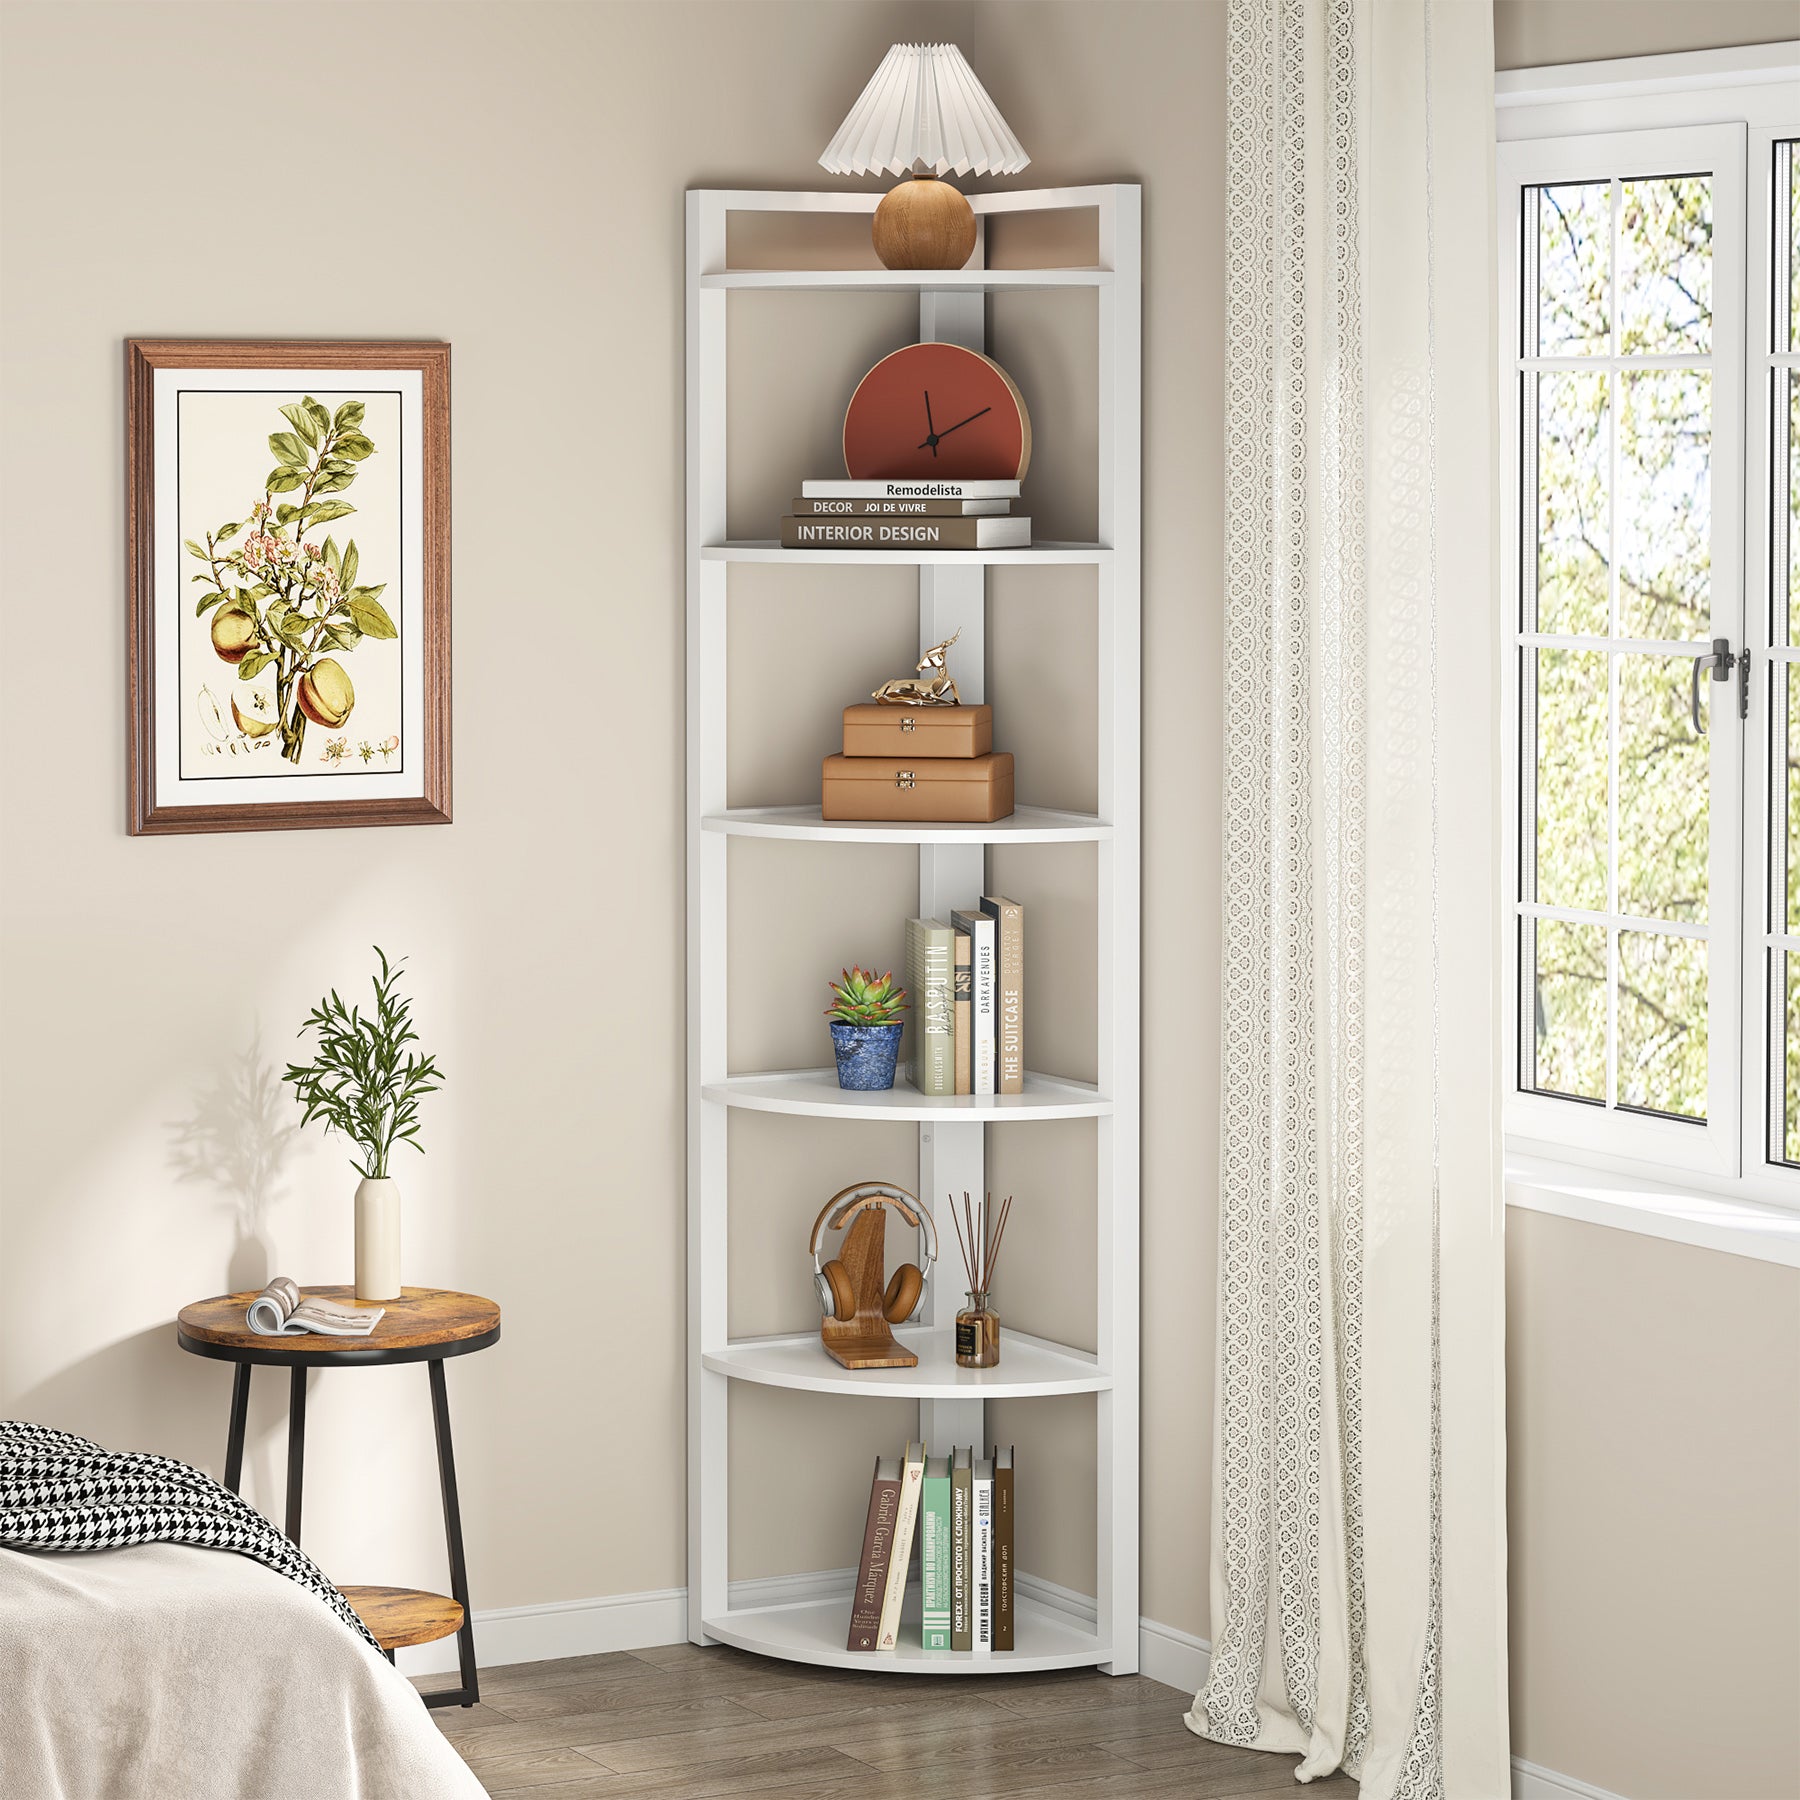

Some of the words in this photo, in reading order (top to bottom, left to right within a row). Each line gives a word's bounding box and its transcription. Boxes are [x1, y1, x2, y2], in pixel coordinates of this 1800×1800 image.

[886, 484, 962, 496] Remodelista
[813, 502, 853, 513] DECOR
[864, 503, 880, 513] JOI
[883, 503, 896, 513] DE
[898, 503, 927, 513] VIVRE
[798, 525, 873, 541] INTERIOR
[879, 526, 940, 542] DESIGN
[925, 946, 948, 1034] RASPUTIN
[1005, 990, 1018, 1052] SUITCASE
[1005, 1057, 1018, 1080] THE
[877, 1489, 896, 1525] Gabriel
[955, 1488, 964, 1536] СЛОЖНОМУ
[871, 1527, 890, 1559] García
[955, 1546, 963, 1586] ПРОСТОГО
[862, 1562, 884, 1604] Márquez
[955, 1587, 963, 1598] ОТ
[979, 1583, 989, 1607] ОСЕВОЙ
[955, 1602, 963, 1632] FOREX:
[980, 1609, 989, 1617] НА
[980, 1619, 989, 1642] ПРЯТКИ
